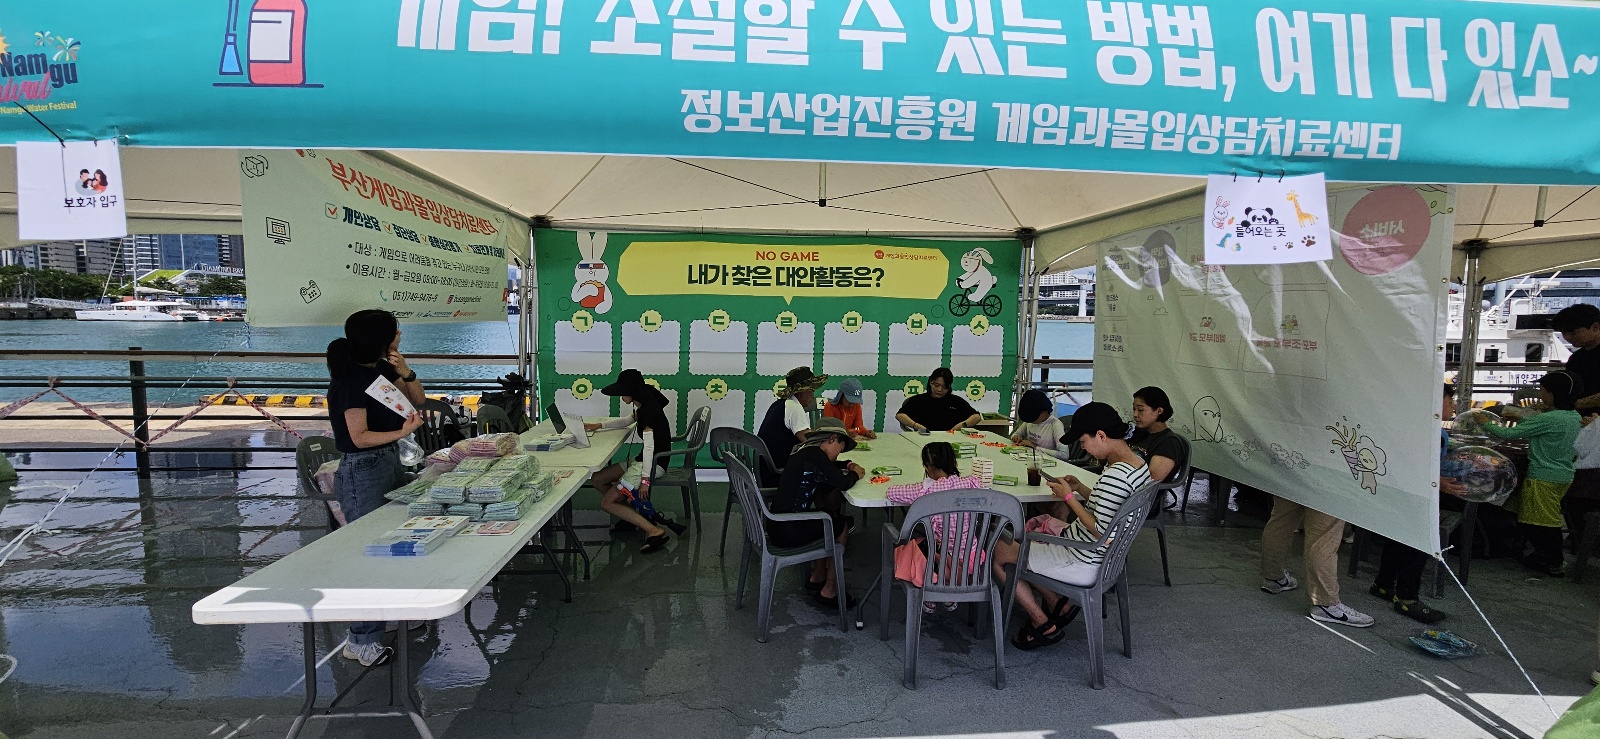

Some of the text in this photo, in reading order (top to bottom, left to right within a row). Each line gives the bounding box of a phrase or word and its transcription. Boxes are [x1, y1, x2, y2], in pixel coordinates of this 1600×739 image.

[839, 0, 907, 70] 수
[929, 0, 1067, 78] 있는
[1089, 0, 1236, 102] 방법,
[1255, 7, 1372, 99] 여기
[1391, 16, 1447, 102] 다
[49, 100, 77, 111] Festival
[681, 88, 1402, 160] 정보산업진흥원 게임과몰입상담치료센터
[64, 195, 117, 208] 보호자 입구
[1235, 226, 1287, 238] 들어오는 곳
[354, 241, 372, 256] 대상
[379, 246, 408, 263] 게임으로
[755, 251, 820, 262] NO GAME
[352, 262, 386, 279] 이용시간
[687, 264, 885, 288] 내가 찾은 대안활동은?
[644, 316, 656, 326] ㄴ
[712, 315, 724, 325] ㄷ
[780, 316, 793, 327] ㄹ
[911, 318, 923, 328] ㅂ
[973, 321, 985, 330] ㅅ
[970, 384, 981, 395] ㅎ
